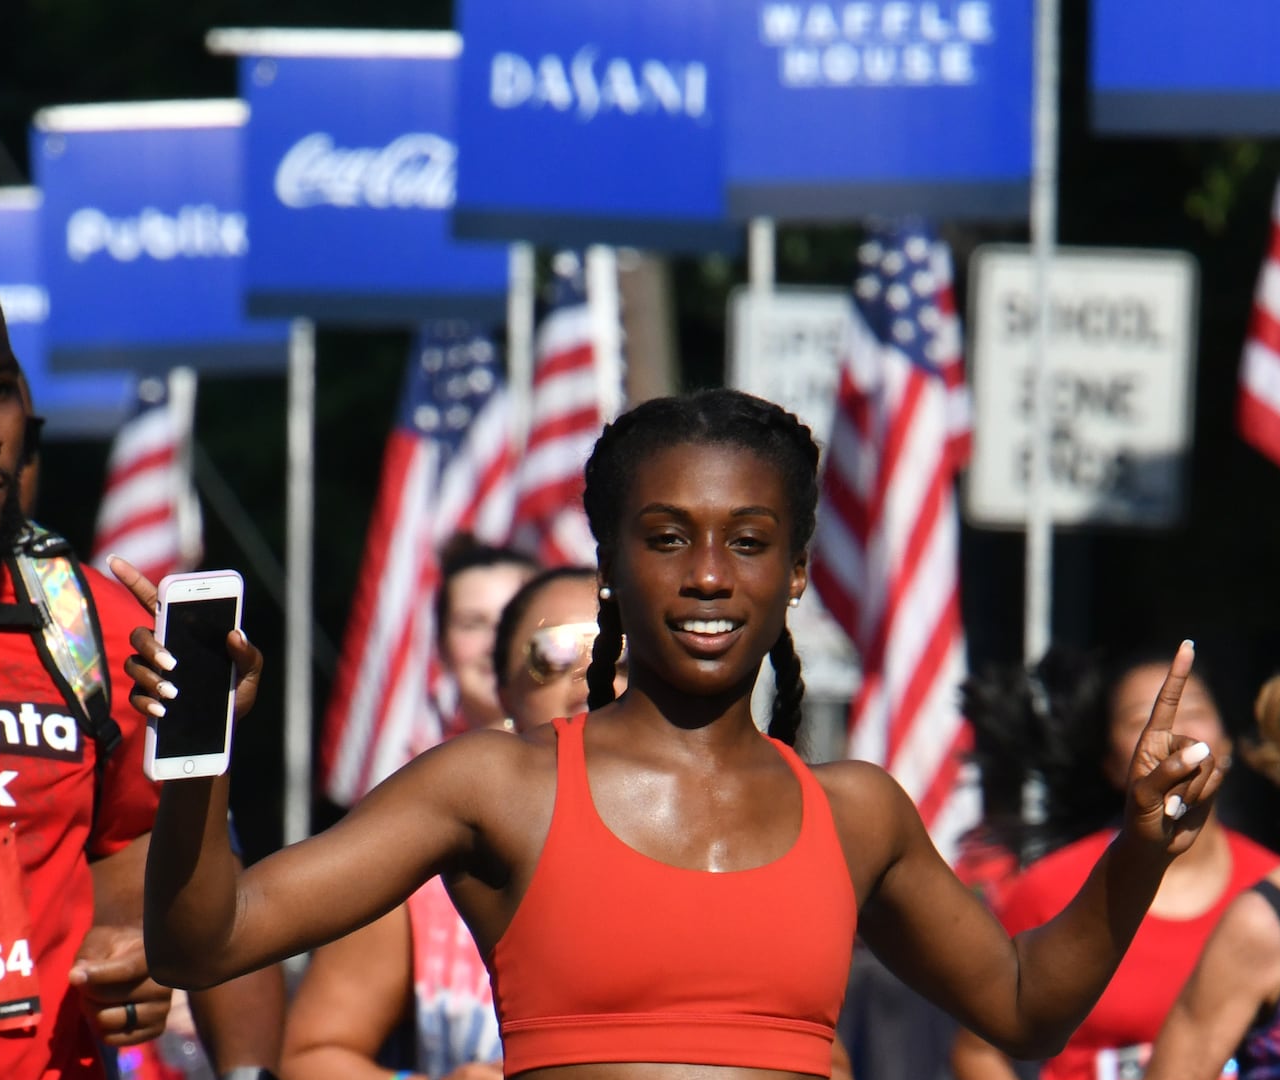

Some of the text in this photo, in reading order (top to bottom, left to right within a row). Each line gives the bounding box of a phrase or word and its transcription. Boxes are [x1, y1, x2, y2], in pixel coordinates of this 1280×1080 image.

[761, 1, 993, 44] WAFFLE
[490, 44, 709, 122] DASANI
[781, 43, 974, 87] HOUSE
